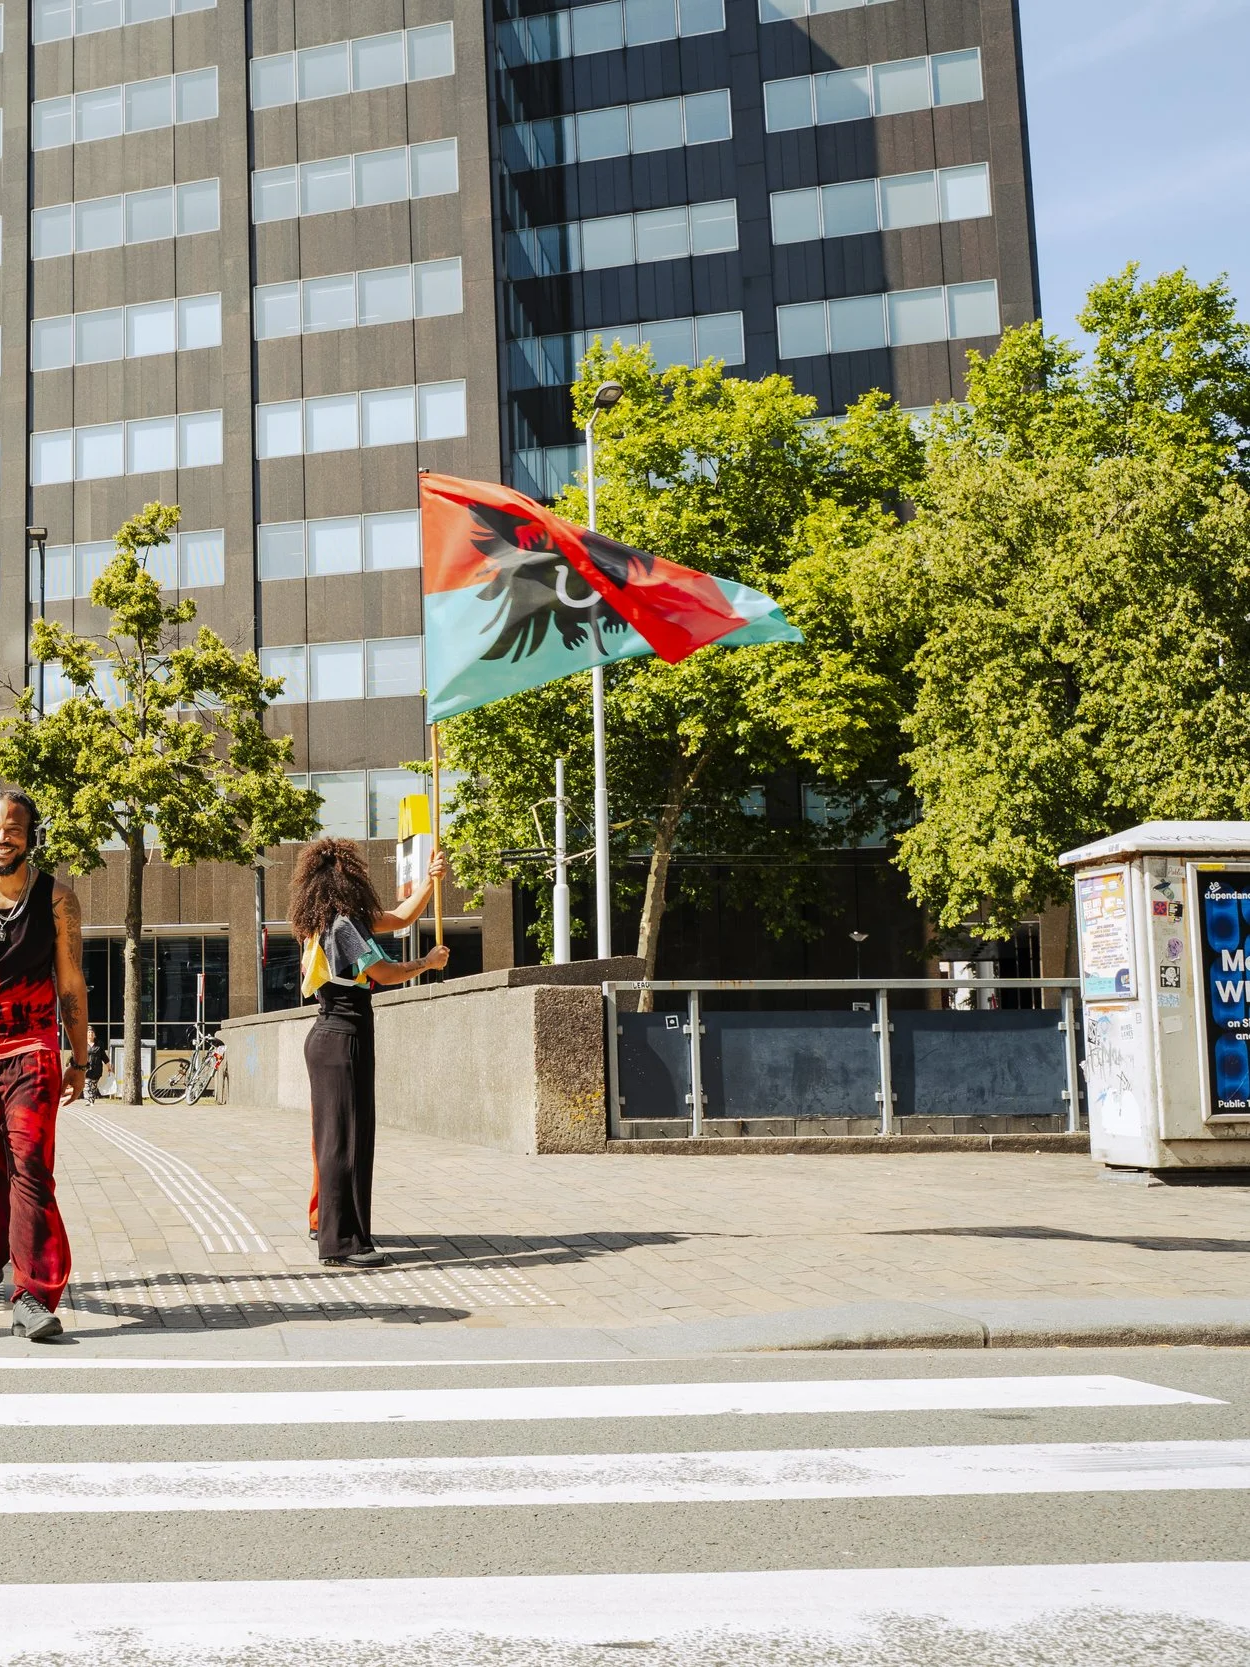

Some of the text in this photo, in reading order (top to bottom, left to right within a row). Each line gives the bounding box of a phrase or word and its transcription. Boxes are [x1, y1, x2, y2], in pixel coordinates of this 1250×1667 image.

[1209, 881, 1221, 891] de
[1227, 1020, 1241, 1028] on
[1218, 1099, 1246, 1108] Public
